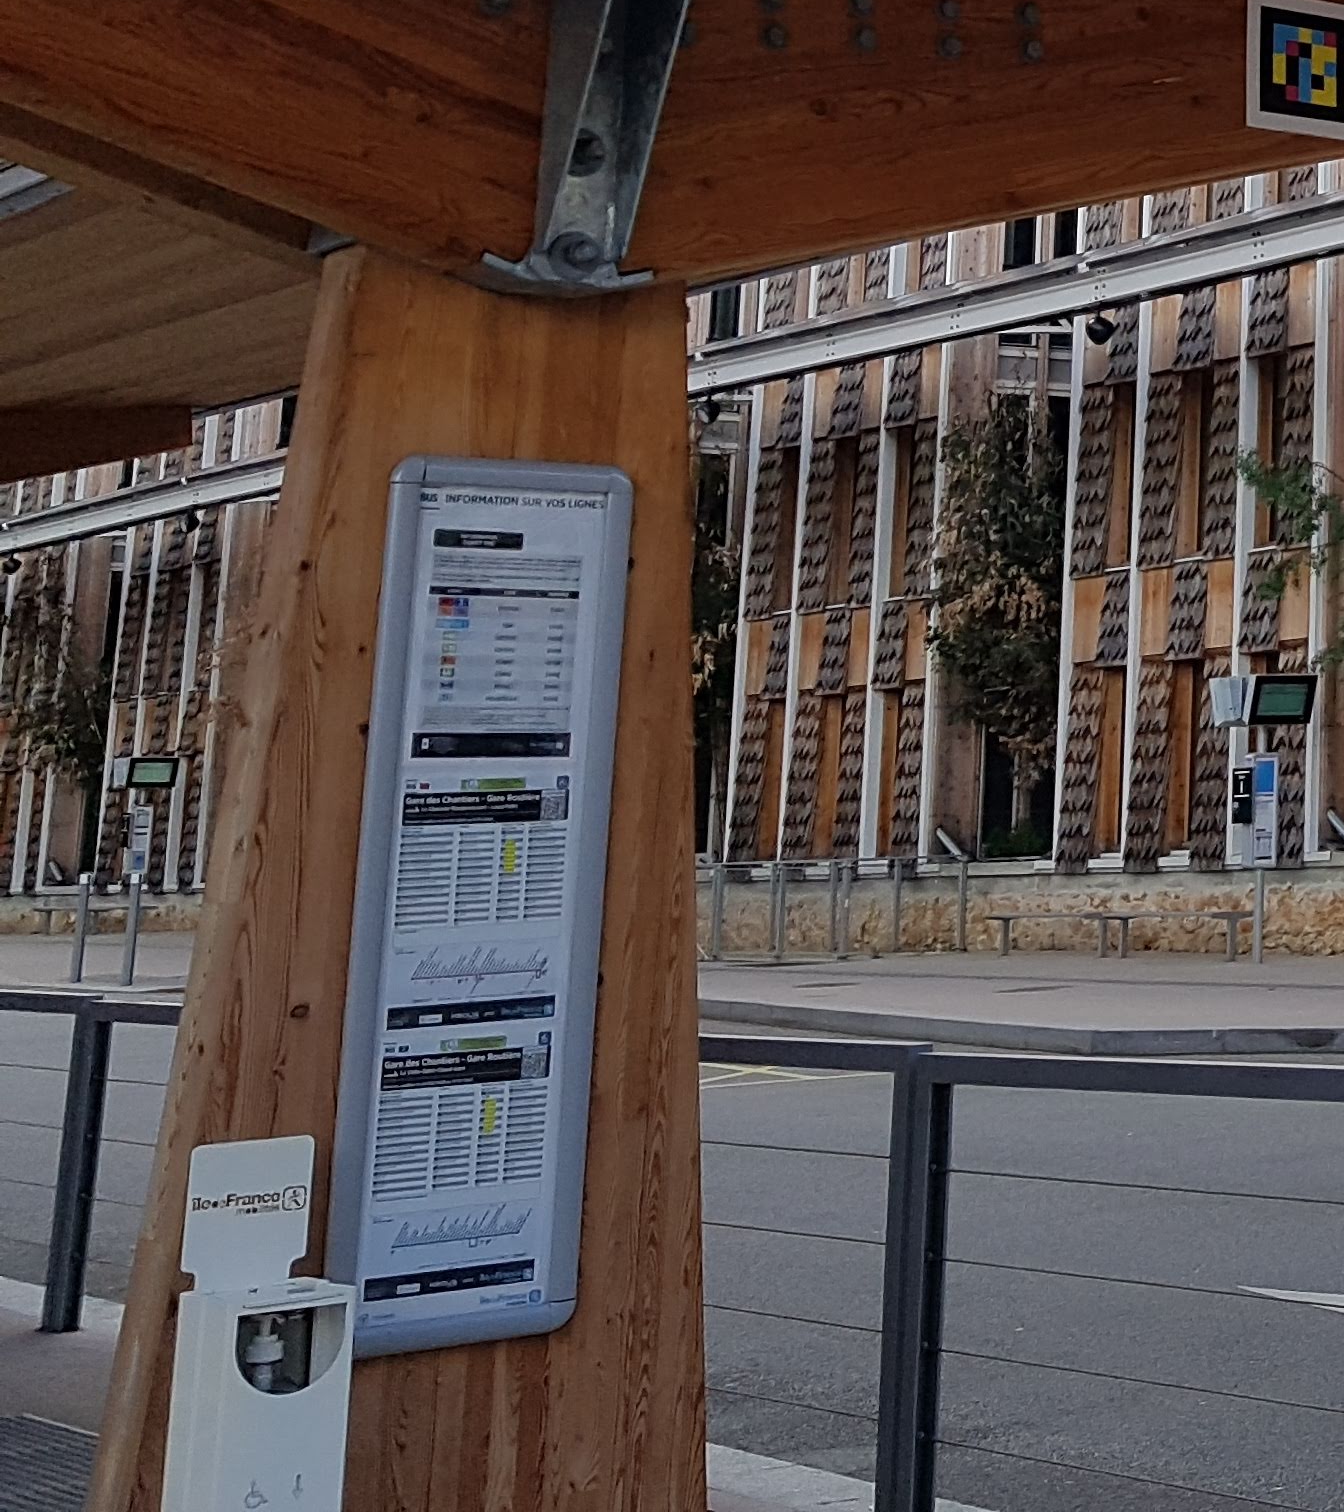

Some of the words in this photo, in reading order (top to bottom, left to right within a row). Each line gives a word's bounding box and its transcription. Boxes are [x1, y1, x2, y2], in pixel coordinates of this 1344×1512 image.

[420, 493, 438, 503] BUS
[445, 494, 519, 506] INFORMATION
[521, 496, 542, 506] SUR
[546, 498, 566, 509] VOS
[568, 499, 604, 509] LIGNES
[442, 794, 480, 804] Chantiers
[422, 1056, 460, 1066] Chantiers
